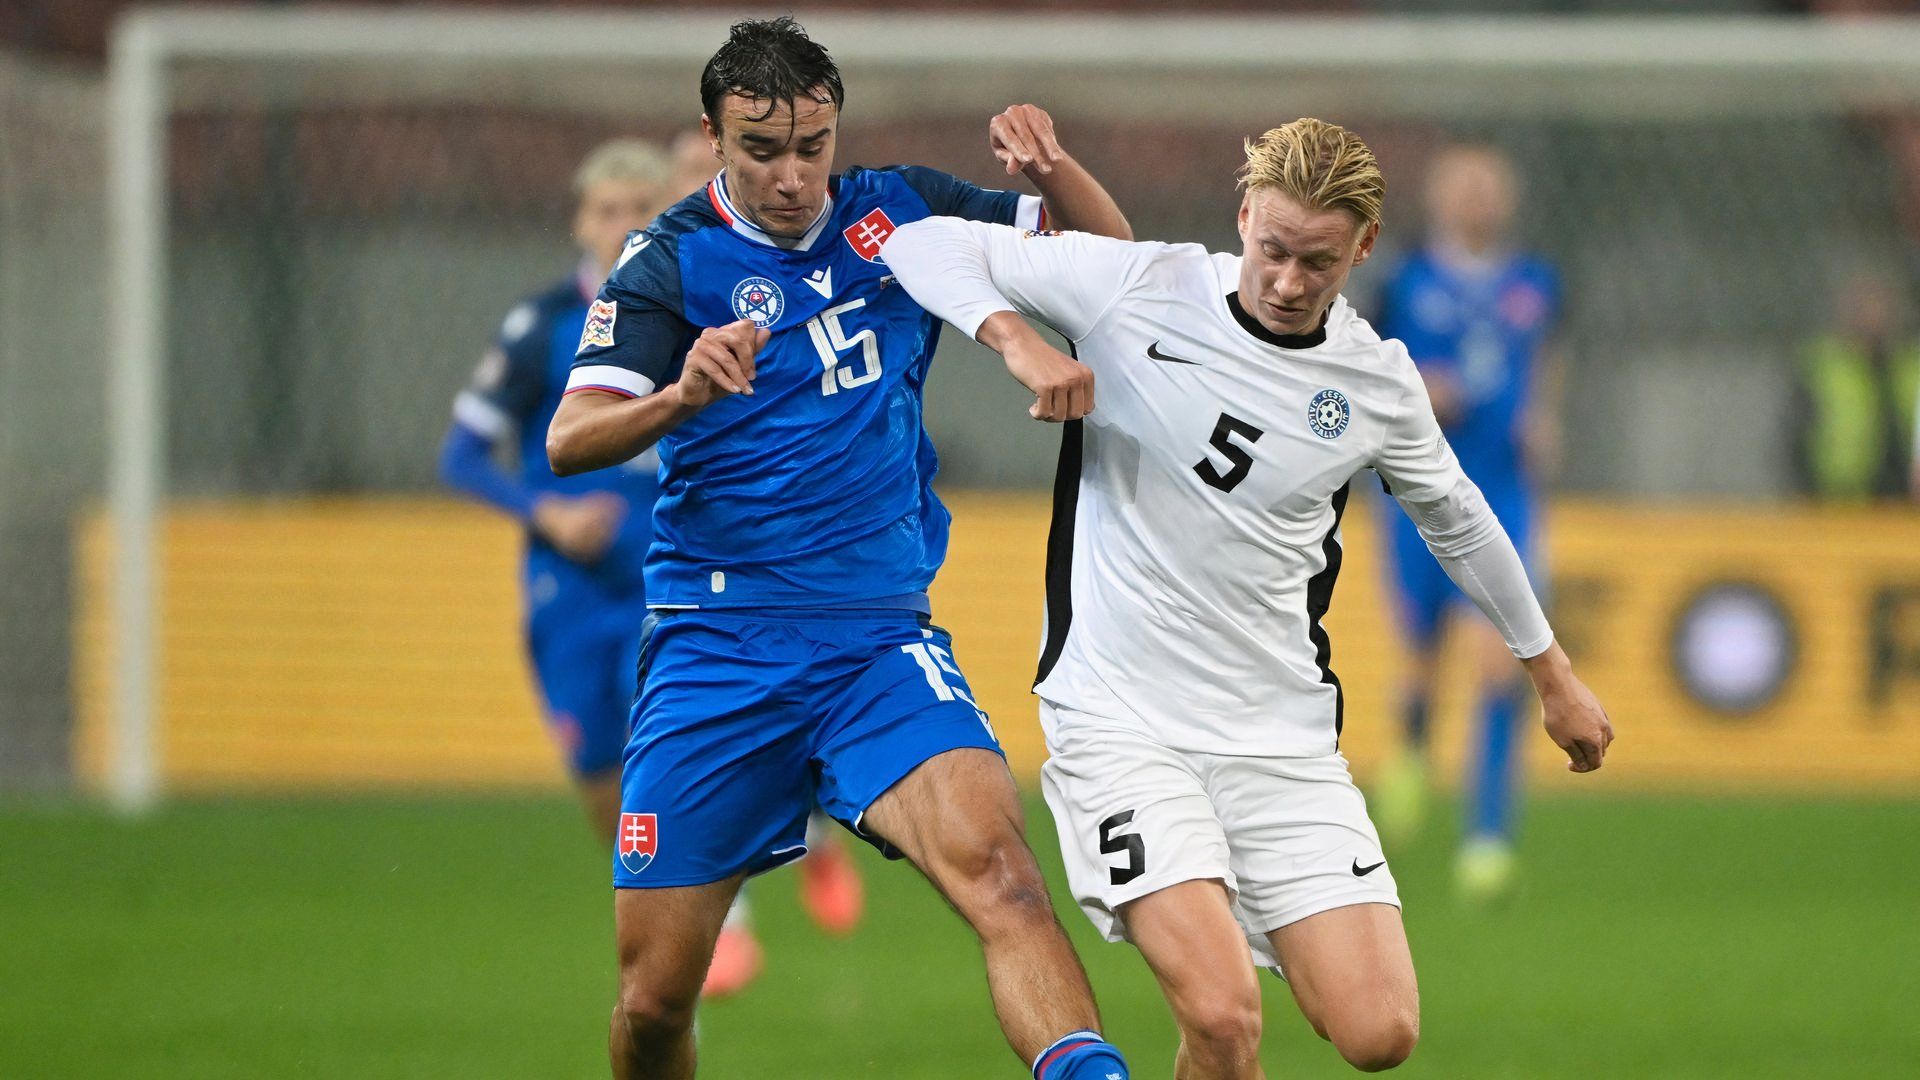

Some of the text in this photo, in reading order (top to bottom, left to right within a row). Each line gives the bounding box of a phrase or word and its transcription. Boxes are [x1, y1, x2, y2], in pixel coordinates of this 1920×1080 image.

[806, 297, 882, 396] 15
[1322, 391, 1346, 405] EESTI
[1192, 411, 1265, 494] 5
[1099, 809, 1145, 885] 5
